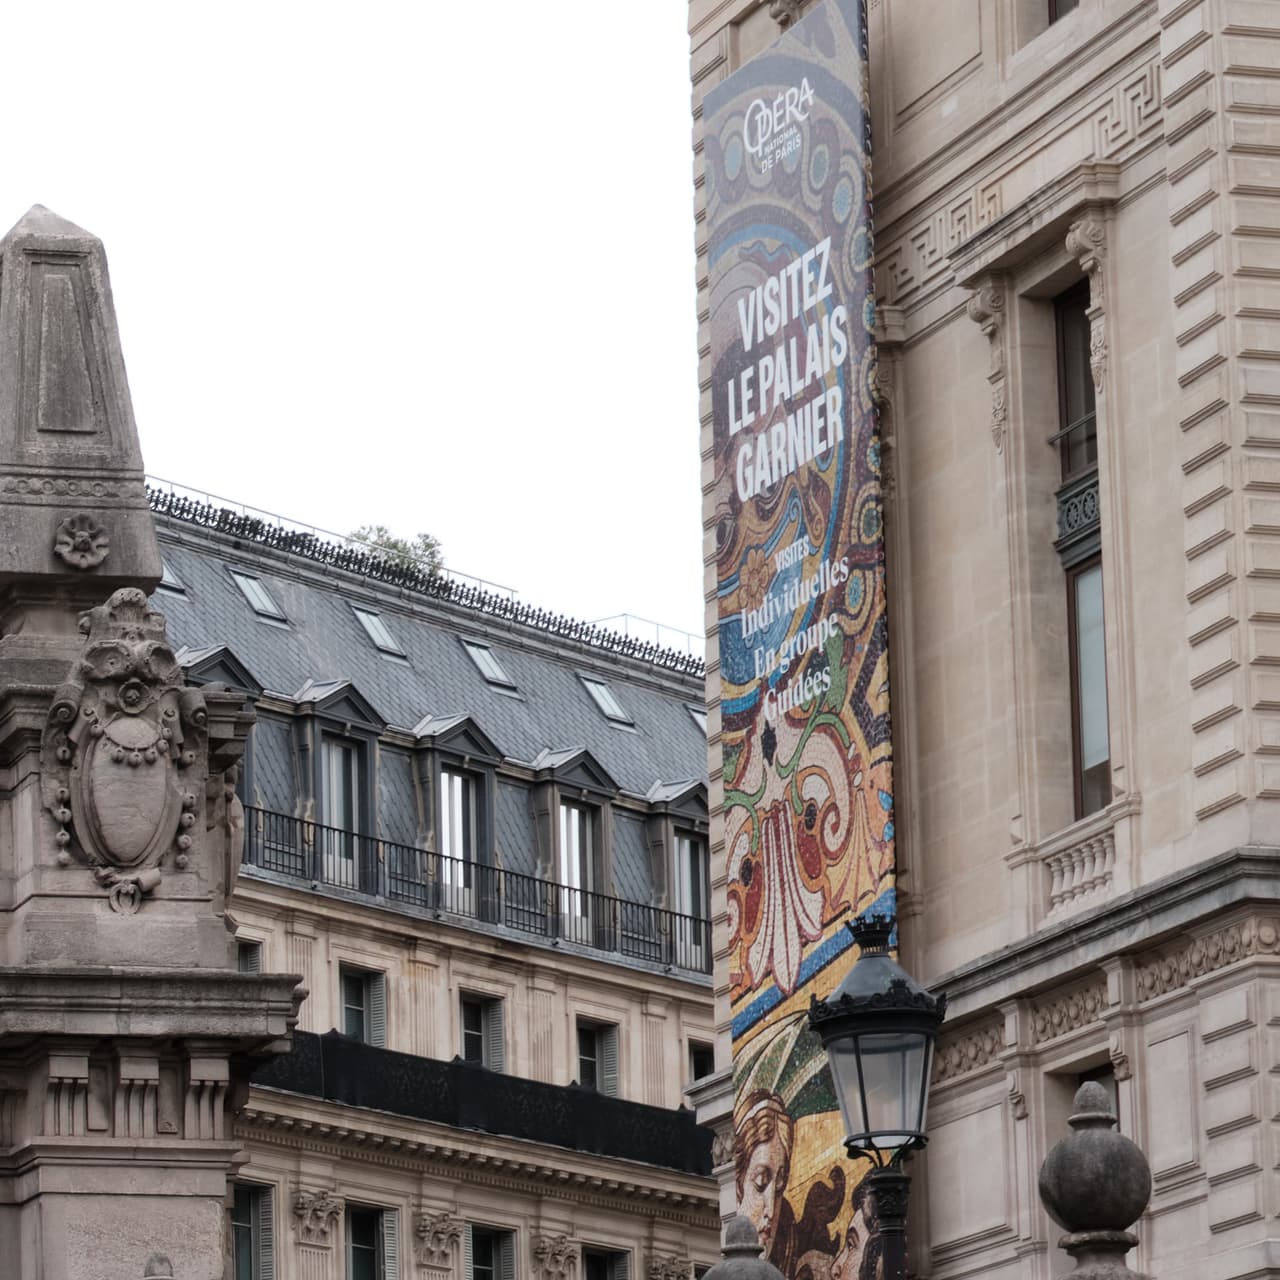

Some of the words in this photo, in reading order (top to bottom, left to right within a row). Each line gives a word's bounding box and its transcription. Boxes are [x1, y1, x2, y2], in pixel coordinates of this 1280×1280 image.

[744, 77, 814, 157] OPÉRA
[761, 154, 774, 174] DE
[776, 134, 801, 163] PARIS
[764, 124, 798, 155] NATIONAL
[738, 236, 833, 353] VISITEZ
[728, 366, 756, 436] LE
[759, 304, 848, 416] PALAIS
[736, 385, 845, 503] GARNIER
[775, 534, 810, 572] VISITES
[741, 556, 849, 639] Individuelles
[754, 648, 776, 681] En
[779, 612, 839, 674] groupe
[763, 665, 832, 722] Guidées
